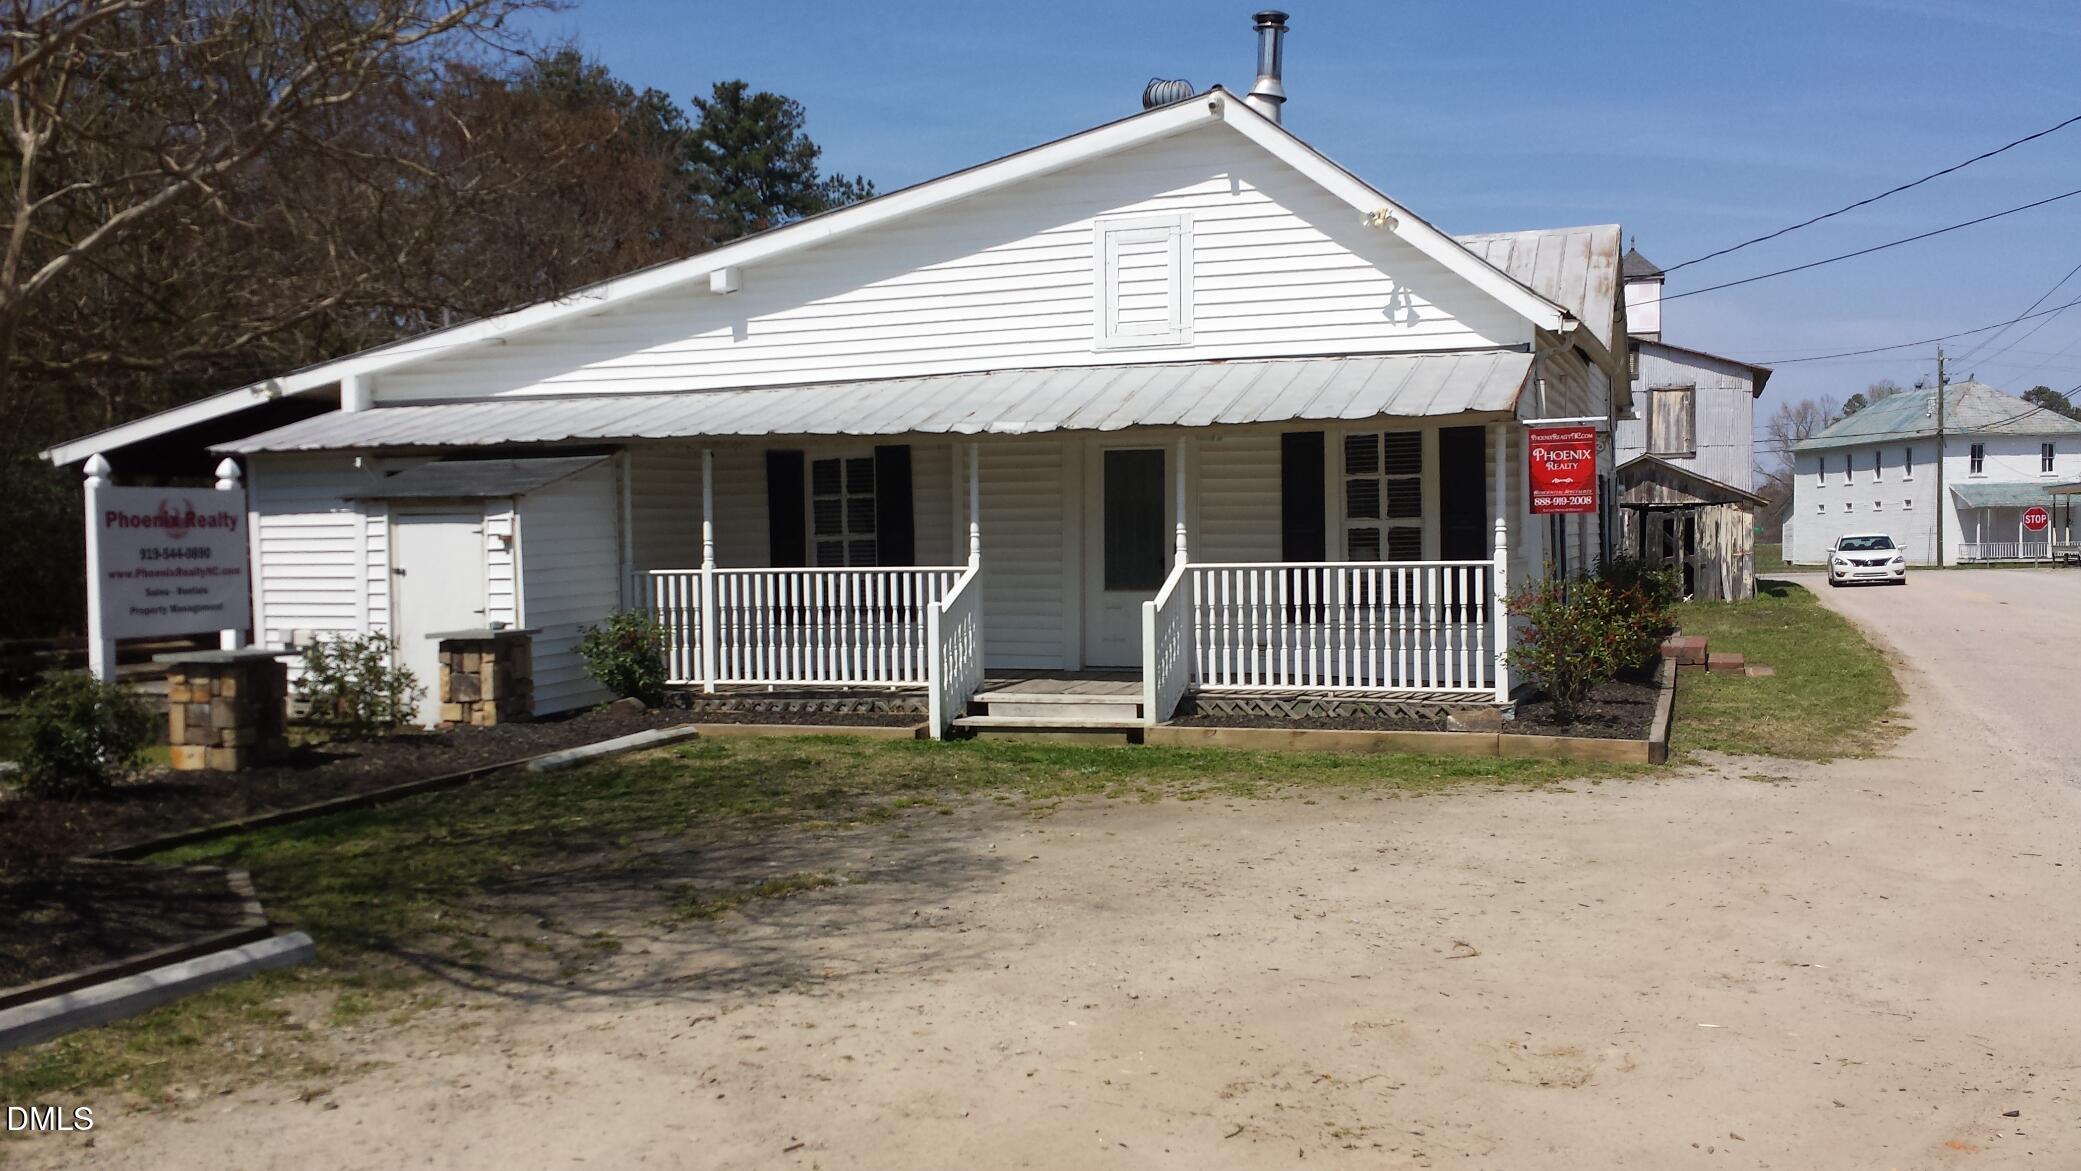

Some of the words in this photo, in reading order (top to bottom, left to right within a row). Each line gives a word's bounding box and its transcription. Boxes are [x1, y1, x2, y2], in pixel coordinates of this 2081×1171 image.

[1532, 448, 1592, 461] PHOENIX
[1546, 461, 1579, 471] REALTY
[1534, 496, 1592, 506] 888-919-2008
[104, 510, 180, 529] Phoenix
[184, 511, 238, 531] Realty
[2025, 514, 2047, 524] STOP
[129, 605, 167, 616] Property
[169, 602, 223, 614] Management
